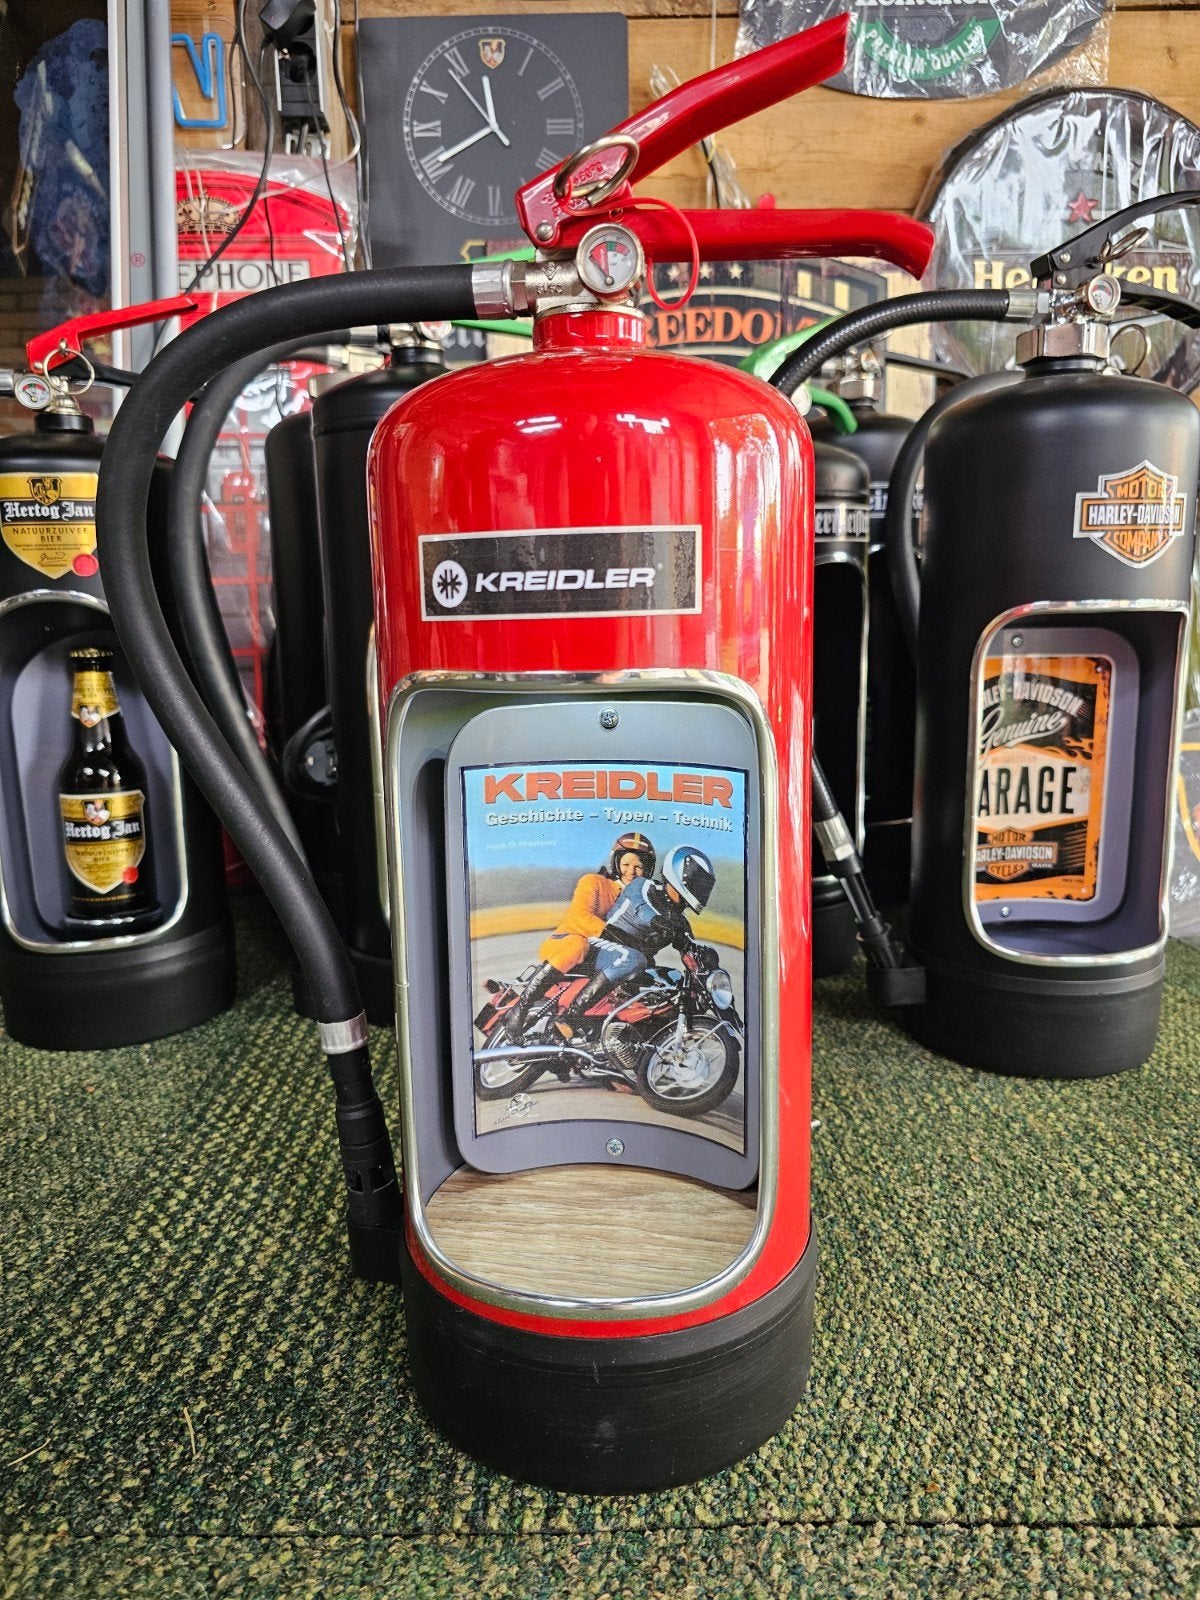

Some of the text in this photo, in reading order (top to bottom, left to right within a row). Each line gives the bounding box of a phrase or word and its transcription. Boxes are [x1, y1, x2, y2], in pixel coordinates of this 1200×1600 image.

[3, 501, 95, 522] Hertog Jan
[1087, 503, 1182, 526] HARLEY-DAVIDSON
[40, 535, 62, 543] BIER
[475, 567, 656, 593] KREIDLER
[484, 770, 734, 809] KREIDLER
[978, 765, 1077, 816] ARAGE
[112, 820, 140, 839] Jan
[485, 807, 584, 827] Geschichte
[604, 806, 655, 825] Typen
[673, 809, 734, 832] Technik
[991, 828, 1026, 845] MOTOR
